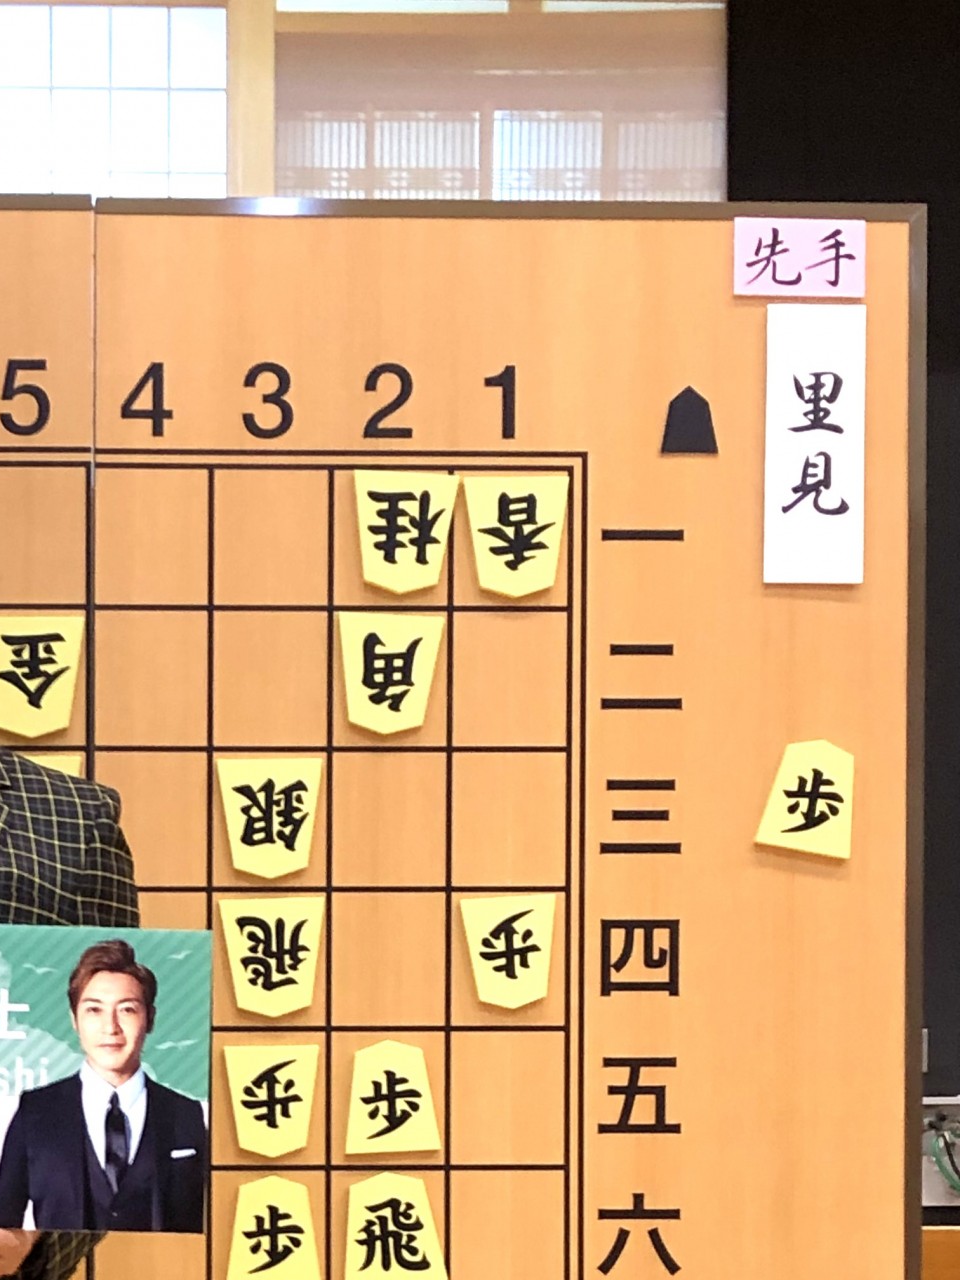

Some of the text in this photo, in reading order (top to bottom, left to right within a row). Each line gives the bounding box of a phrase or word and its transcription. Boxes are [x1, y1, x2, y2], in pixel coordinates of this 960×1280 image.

[747, 228, 855, 286] 先手
[0, 360, 50, 436] 5
[121, 363, 172, 437] 4
[243, 363, 293, 439] 3
[363, 363, 412, 438] 2
[485, 366, 515, 439] 1
[782, 372, 849, 515] 里見
[368, 491, 444, 564] 桂
[478, 493, 553, 570] 香
[362, 633, 422, 712] 角
[233, 779, 308, 851] 銀
[782, 769, 843, 832] 歩
[236, 917, 309, 991] 飛
[480, 911, 540, 979] 歩
[601, 919, 679, 996] 四
[241, 1061, 302, 1128] 歩
[361, 1071, 421, 1139] 歩
[598, 1057, 681, 1134] 五
[243, 1205, 304, 1273] 歩
[356, 1198, 430, 1271] 飛
[597, 1193, 681, 1275] 六
